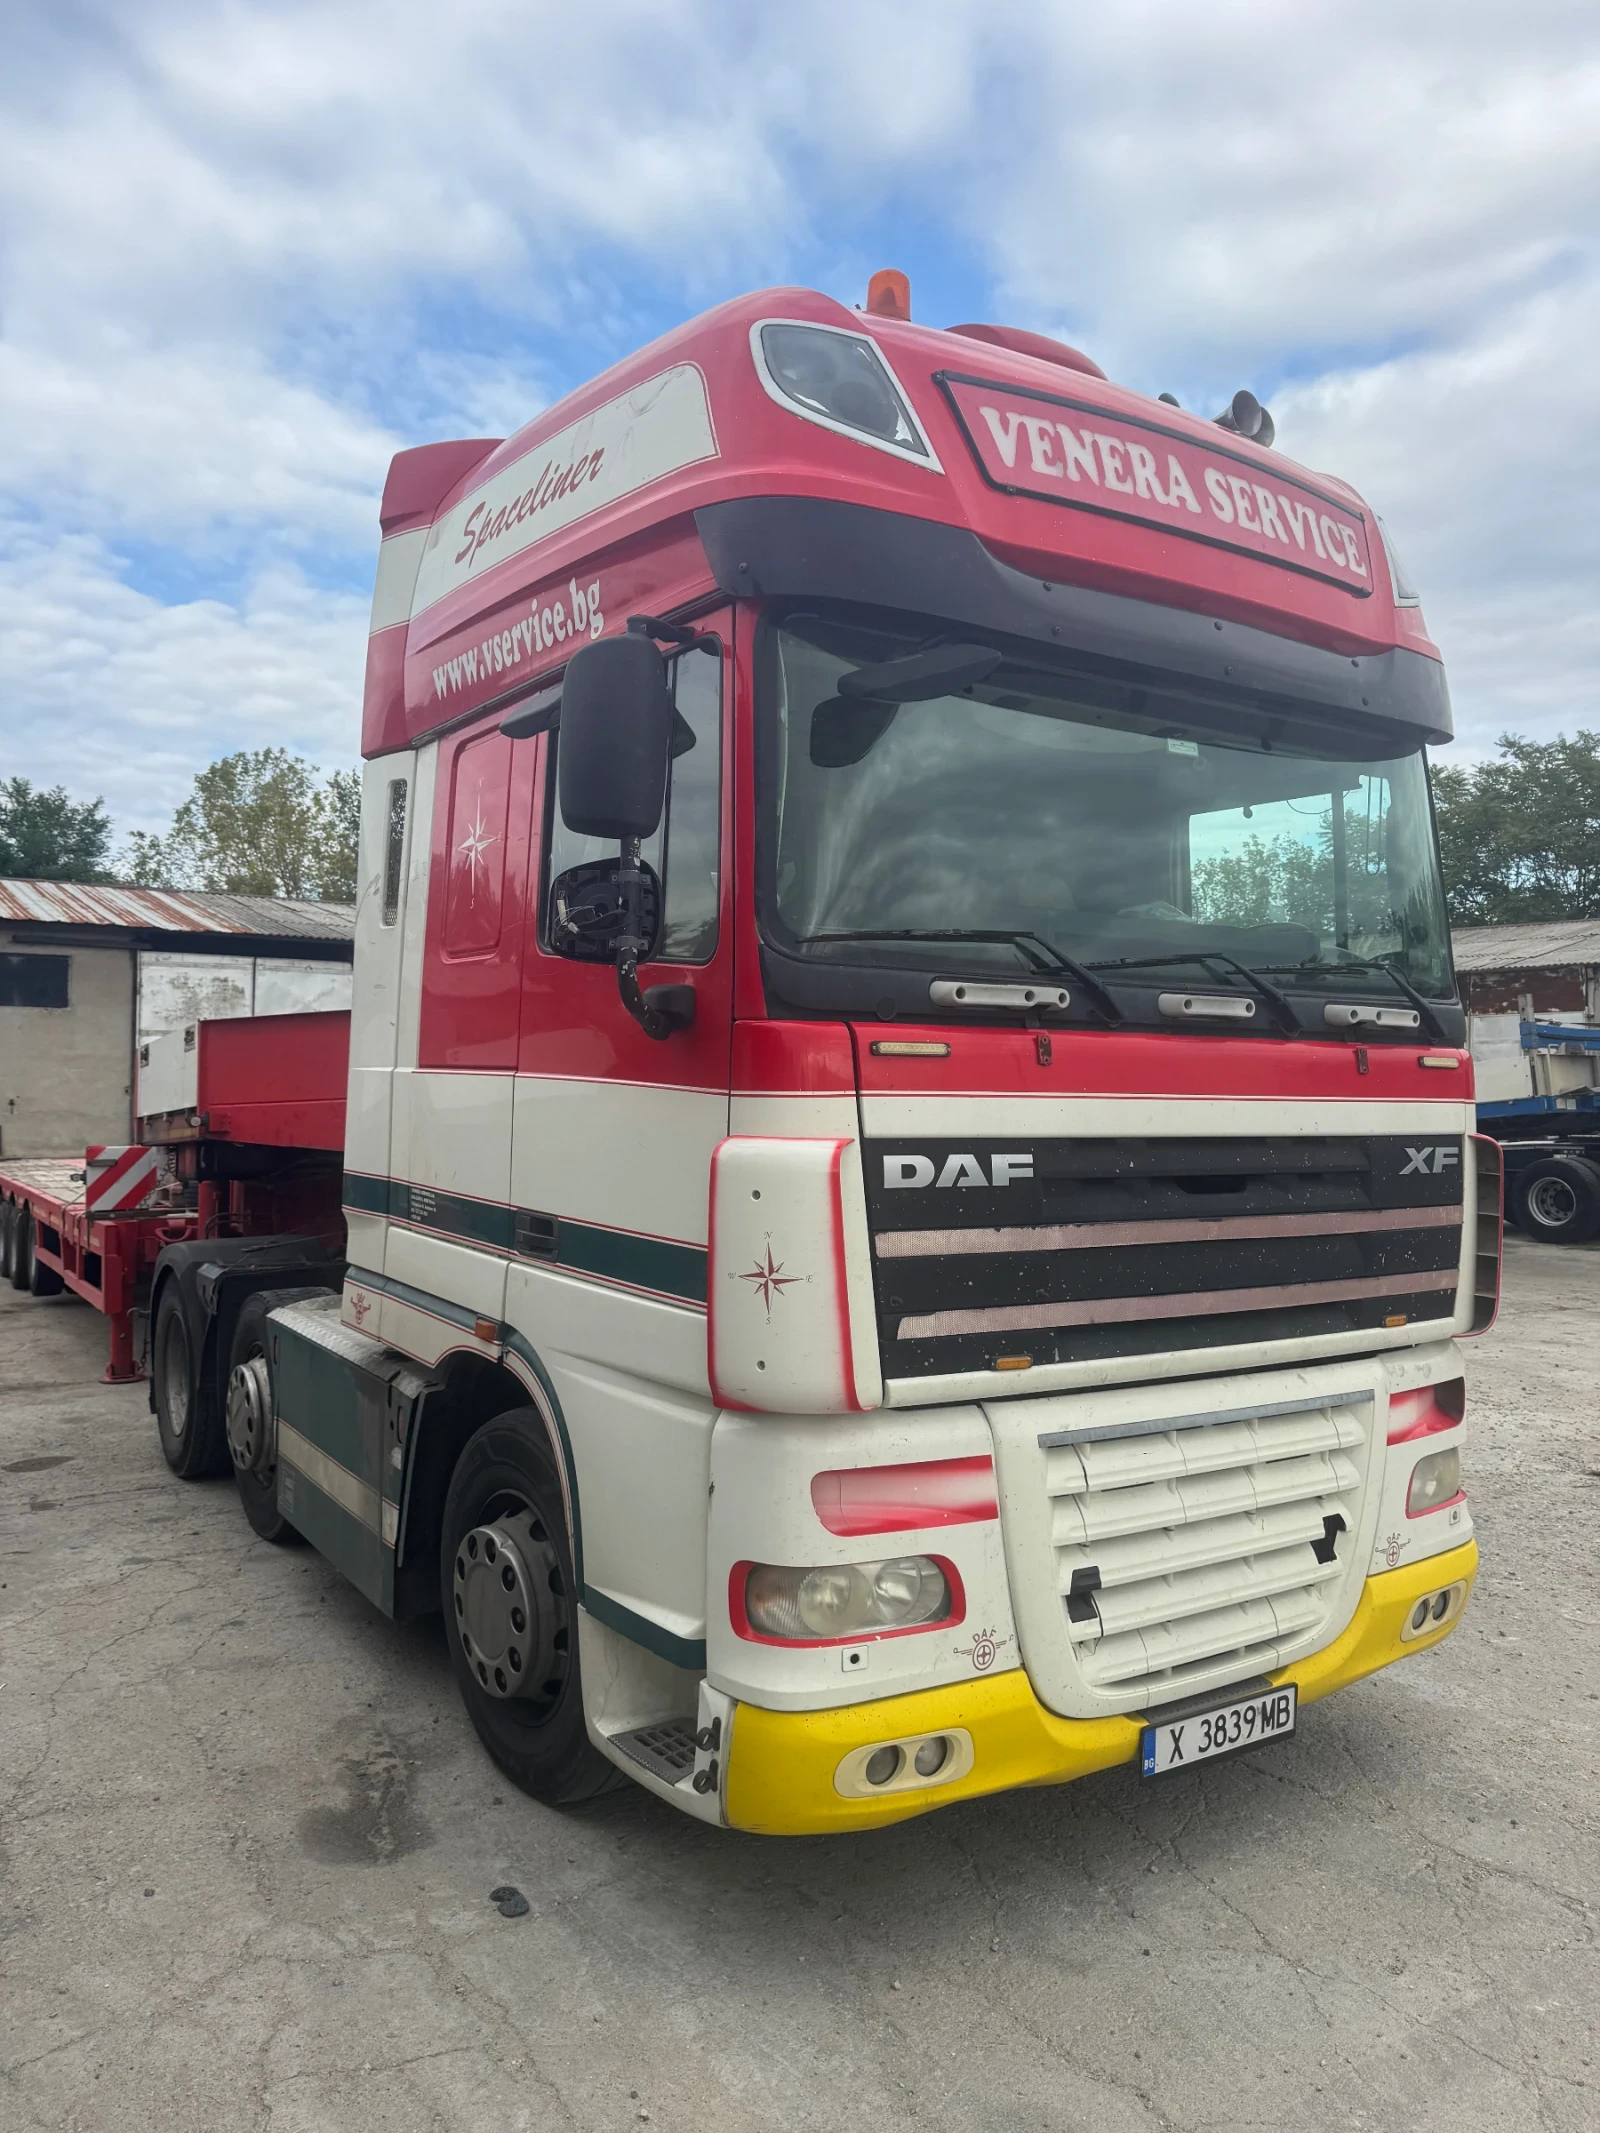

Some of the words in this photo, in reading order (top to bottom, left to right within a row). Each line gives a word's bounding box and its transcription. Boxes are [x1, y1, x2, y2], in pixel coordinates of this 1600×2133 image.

[455, 447, 605, 568] Spaceliner
[979, 405, 1202, 514] VENERA
[1203, 466, 1368, 577] SERVICE
[432, 577, 604, 701] www.vservice.bg
[883, 1153, 1034, 1189] DAF
[1398, 1146, 1459, 1175] XF
[972, 1628, 997, 1644] DAF
[1169, 1725, 1185, 1764] X
[1143, 1757, 1155, 1771] BG
